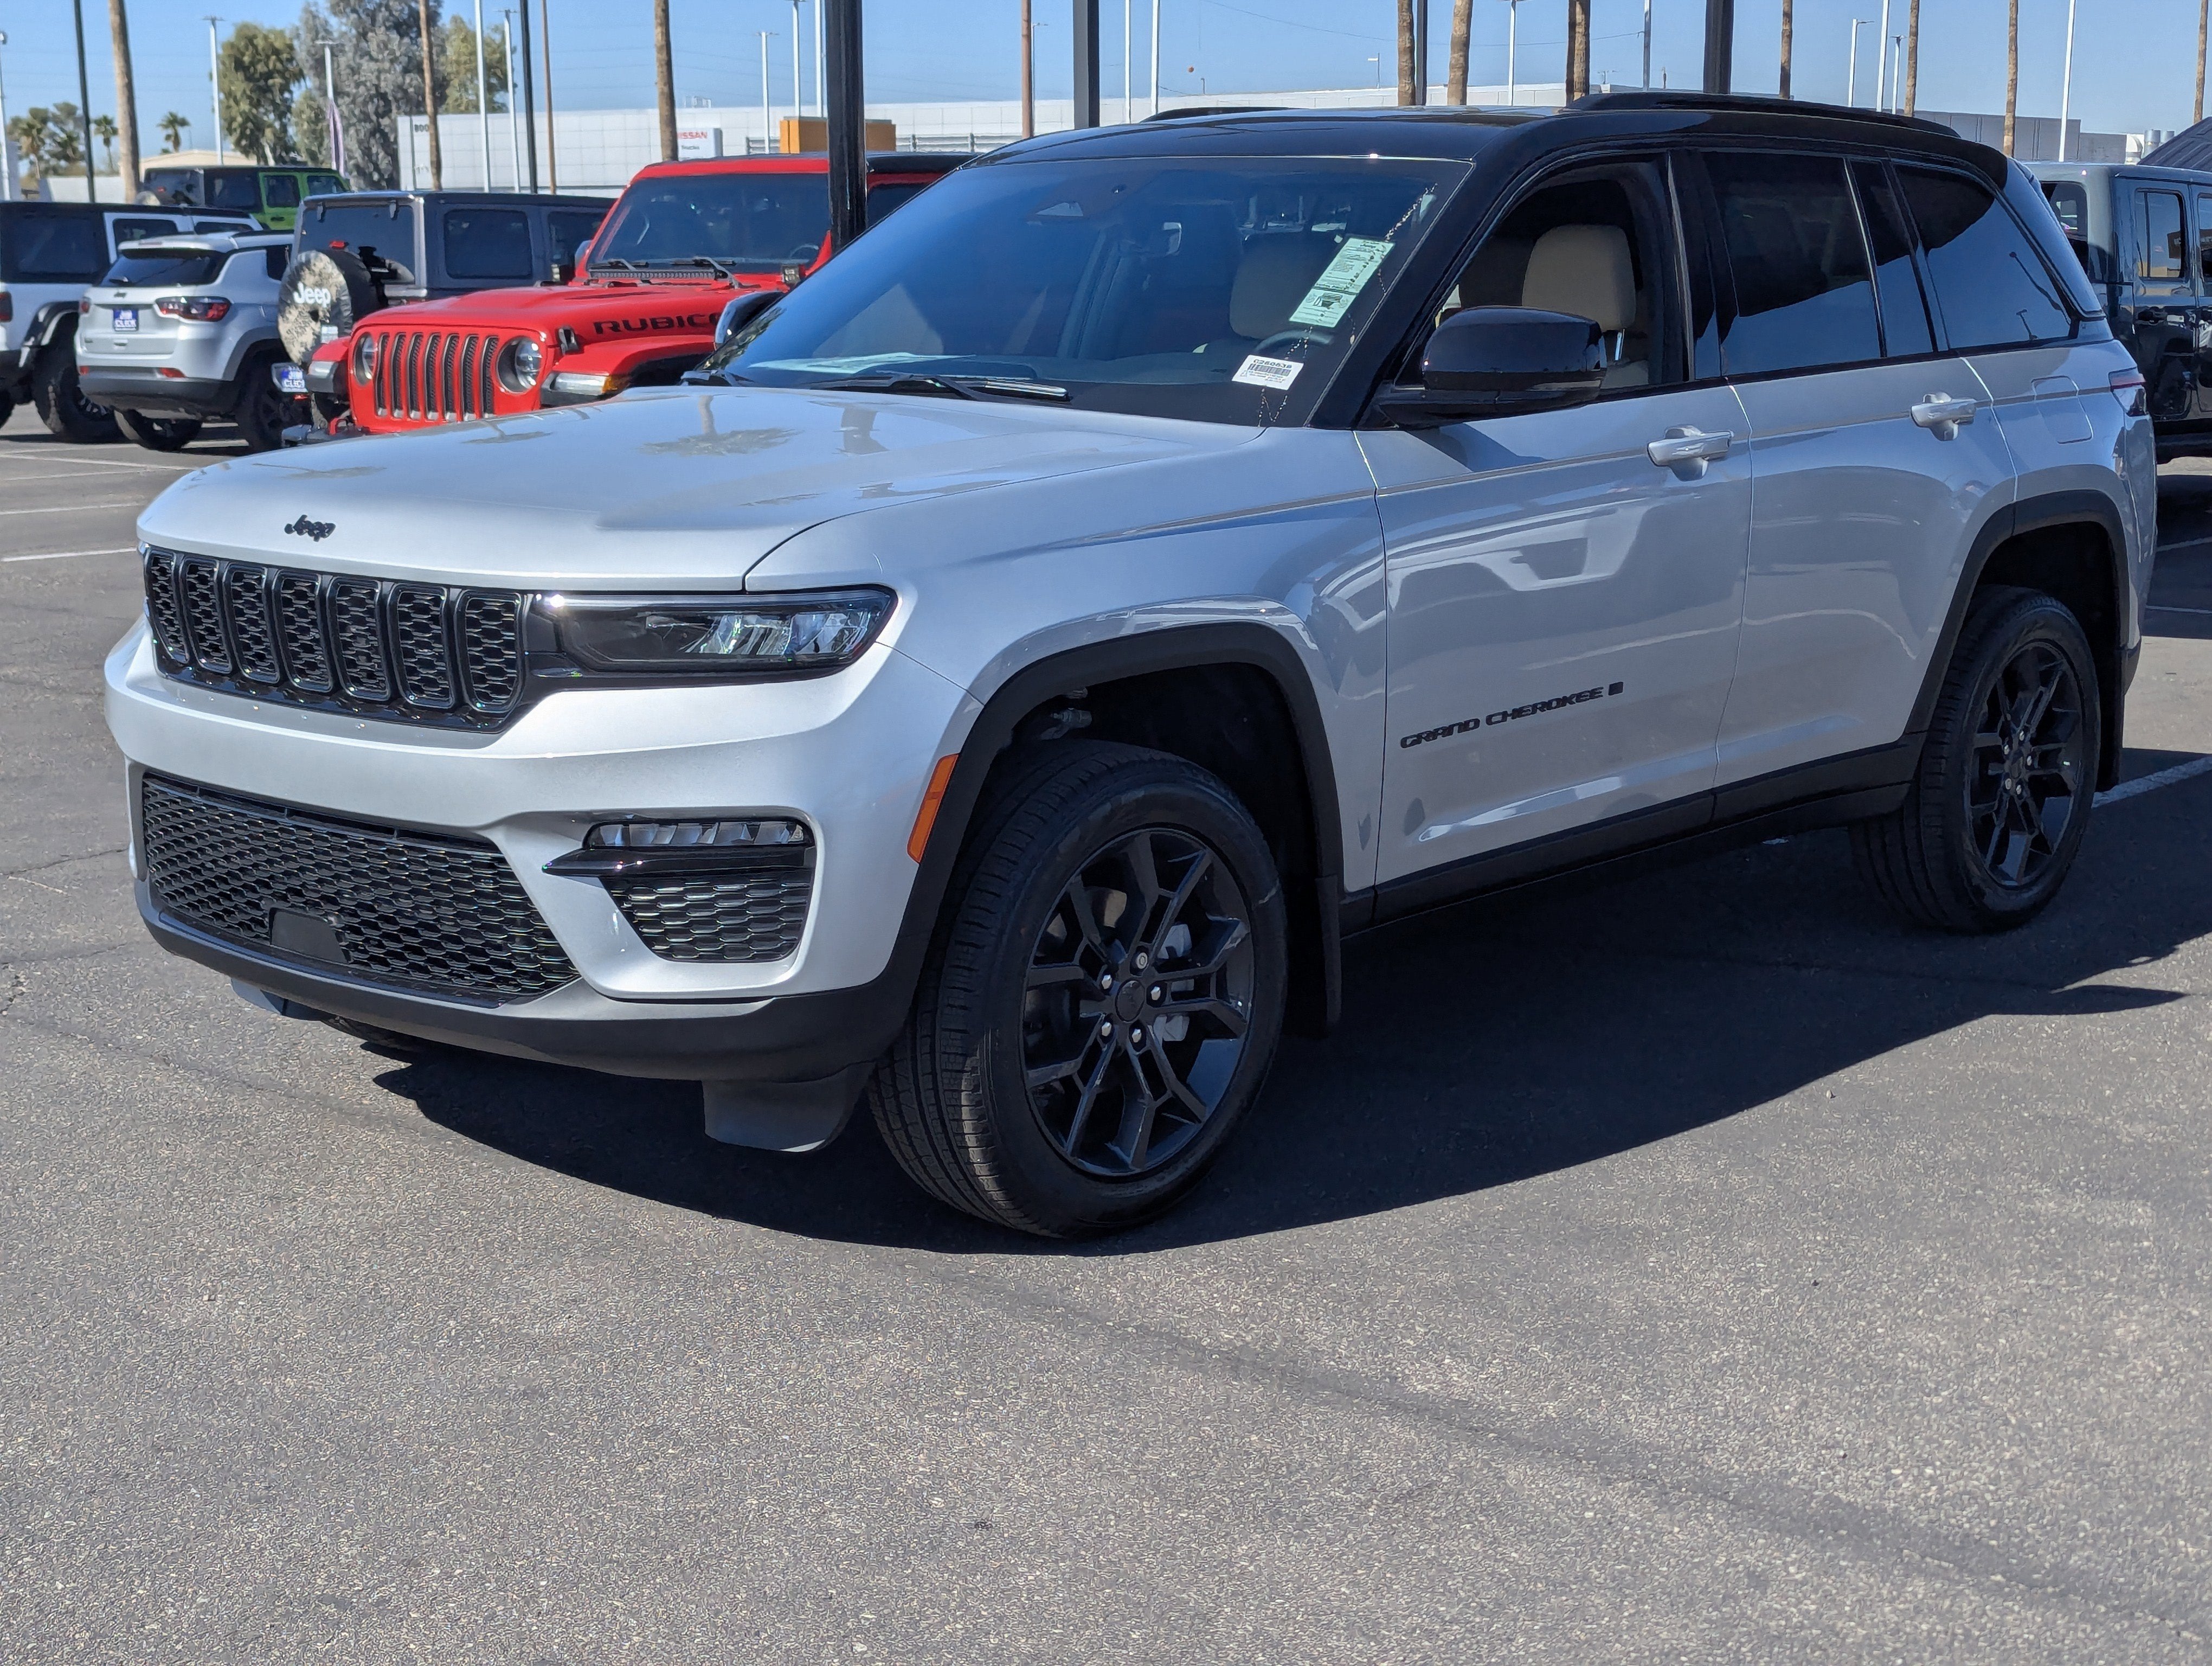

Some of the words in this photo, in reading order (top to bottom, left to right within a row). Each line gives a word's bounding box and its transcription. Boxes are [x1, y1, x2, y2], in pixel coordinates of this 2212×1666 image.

[293, 282, 331, 308] Jeep
[284, 514, 336, 542] Jeep
[1400, 718, 1480, 749] GRAND
[1485, 687, 1604, 726] CHEROKEE
